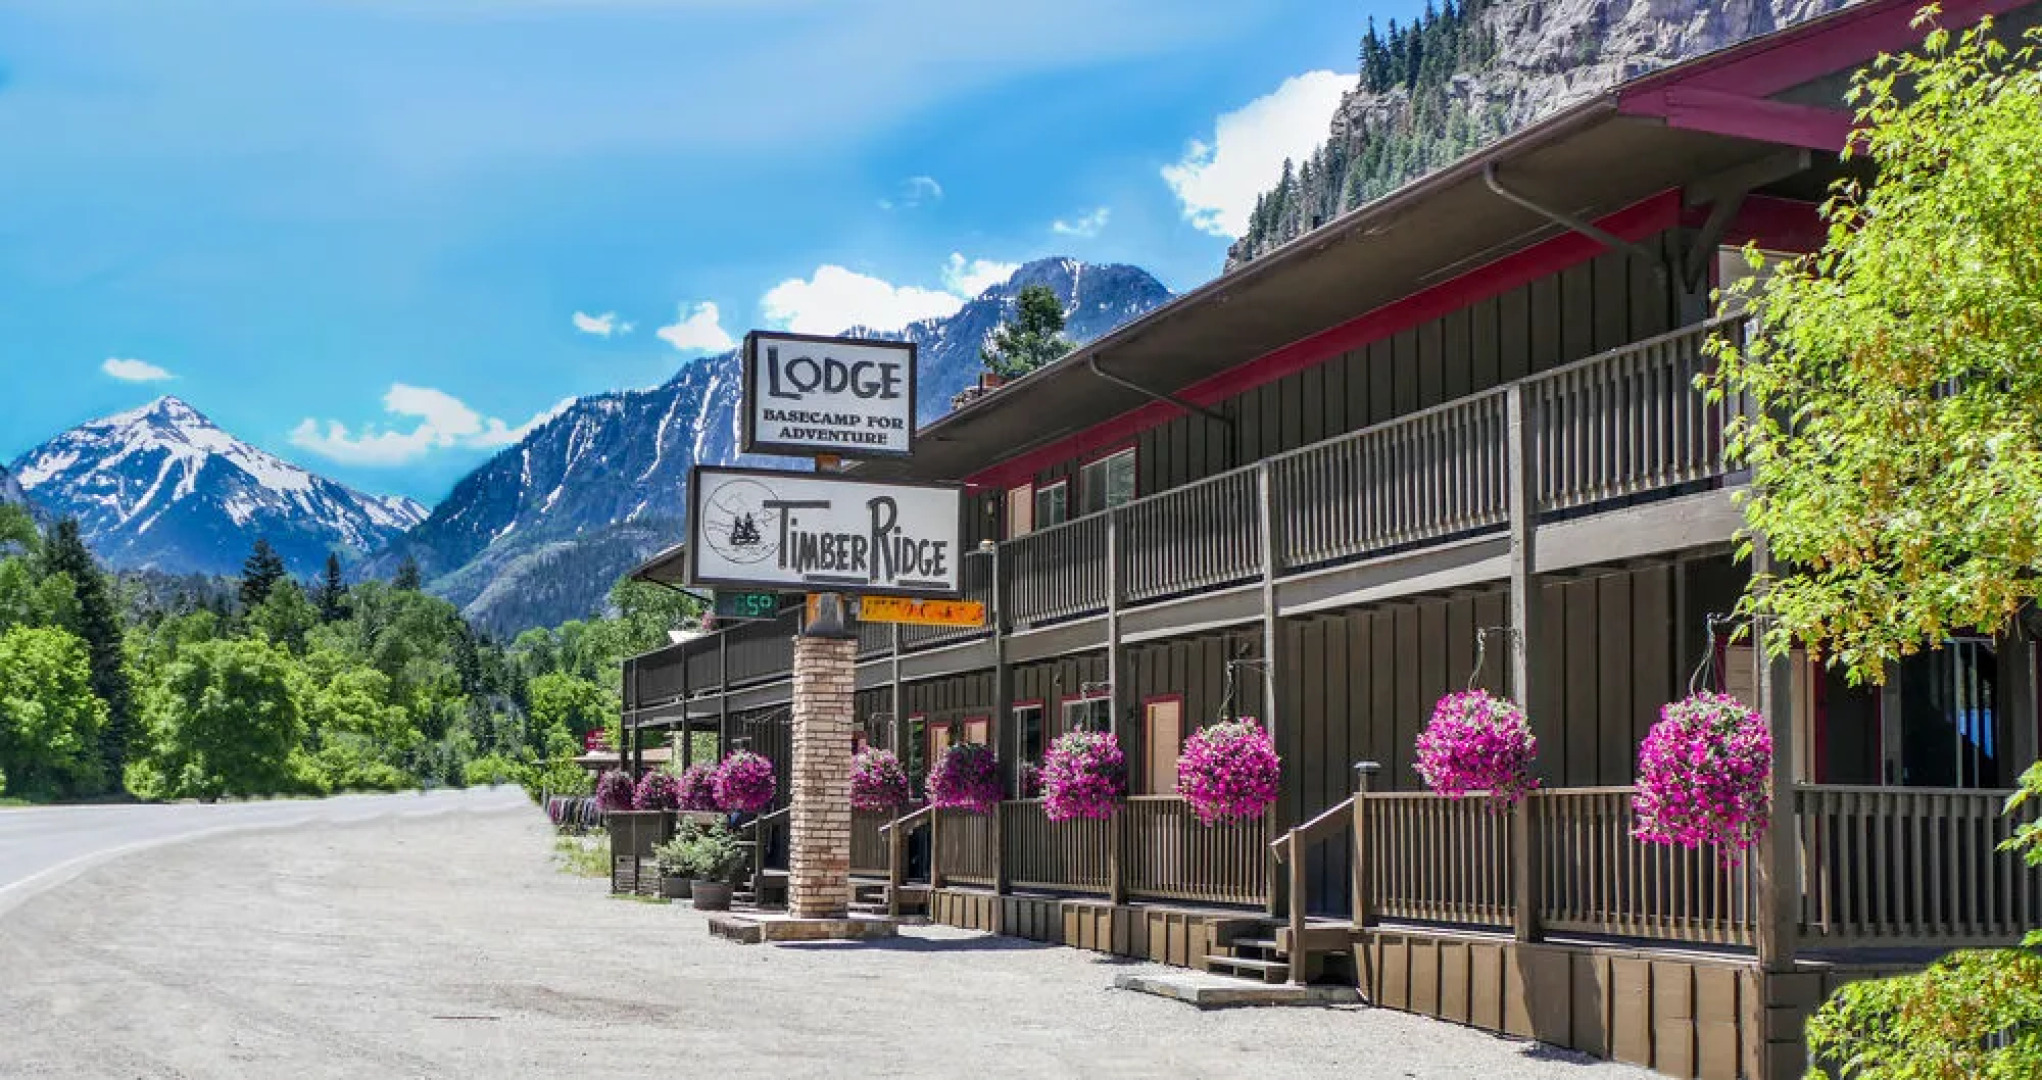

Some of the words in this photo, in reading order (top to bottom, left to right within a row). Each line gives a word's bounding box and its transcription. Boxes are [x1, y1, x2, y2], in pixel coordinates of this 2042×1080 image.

[767, 346, 902, 400] LODGE
[762, 408, 860, 426] BASECAMP
[867, 415, 904, 430] FOR
[778, 426, 888, 445] ADVENTURE
